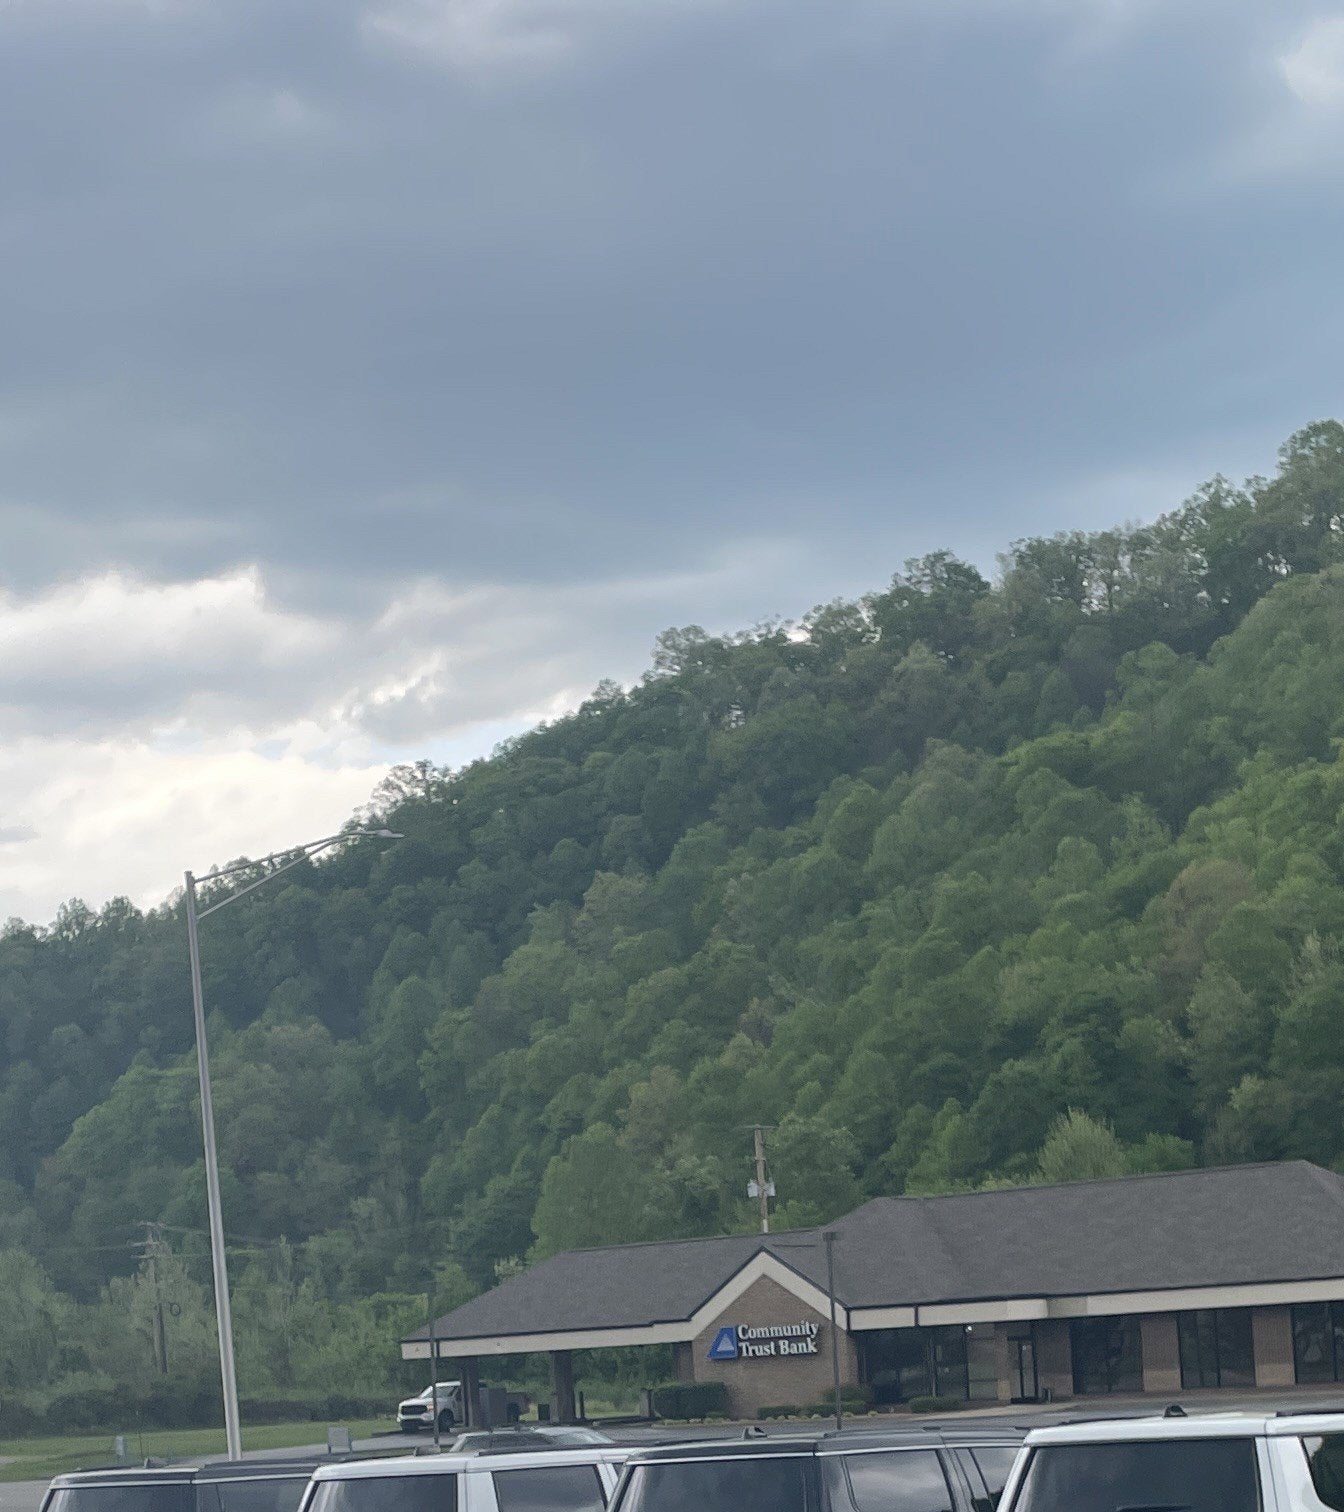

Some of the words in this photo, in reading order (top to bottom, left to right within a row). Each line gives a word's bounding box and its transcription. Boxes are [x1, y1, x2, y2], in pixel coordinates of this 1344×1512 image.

[737, 1319, 820, 1339] Community
[738, 1340, 777, 1358] Trust
[778, 1337, 819, 1356] Bank
